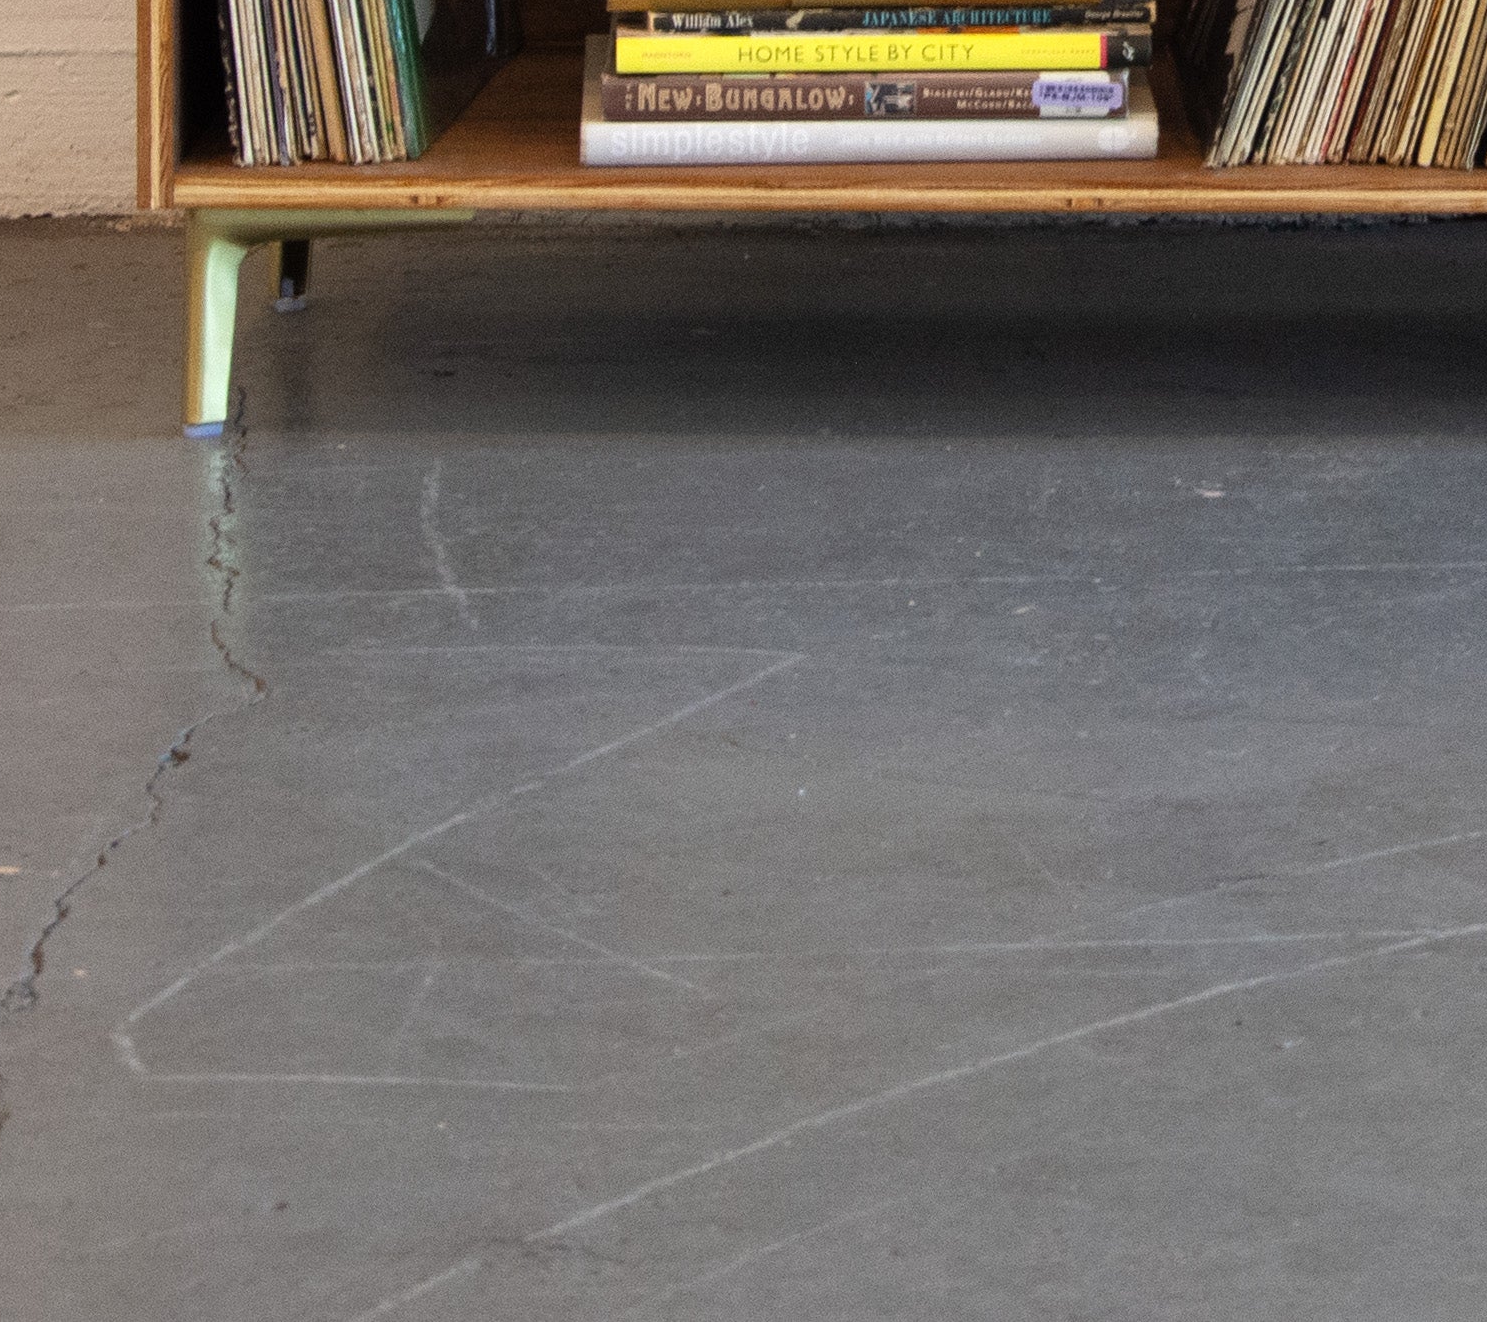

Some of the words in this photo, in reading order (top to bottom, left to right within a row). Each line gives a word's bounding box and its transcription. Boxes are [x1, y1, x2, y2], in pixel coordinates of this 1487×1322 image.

[671, 12, 722, 30] William
[862, 10, 937, 27] JAPANESE
[941, 7, 1052, 26] ARCHITECTURE
[738, 45, 804, 64] HOME
[814, 44, 880, 63] STYLE
[887, 44, 913, 61] BY
[921, 44, 975, 61] CITY
